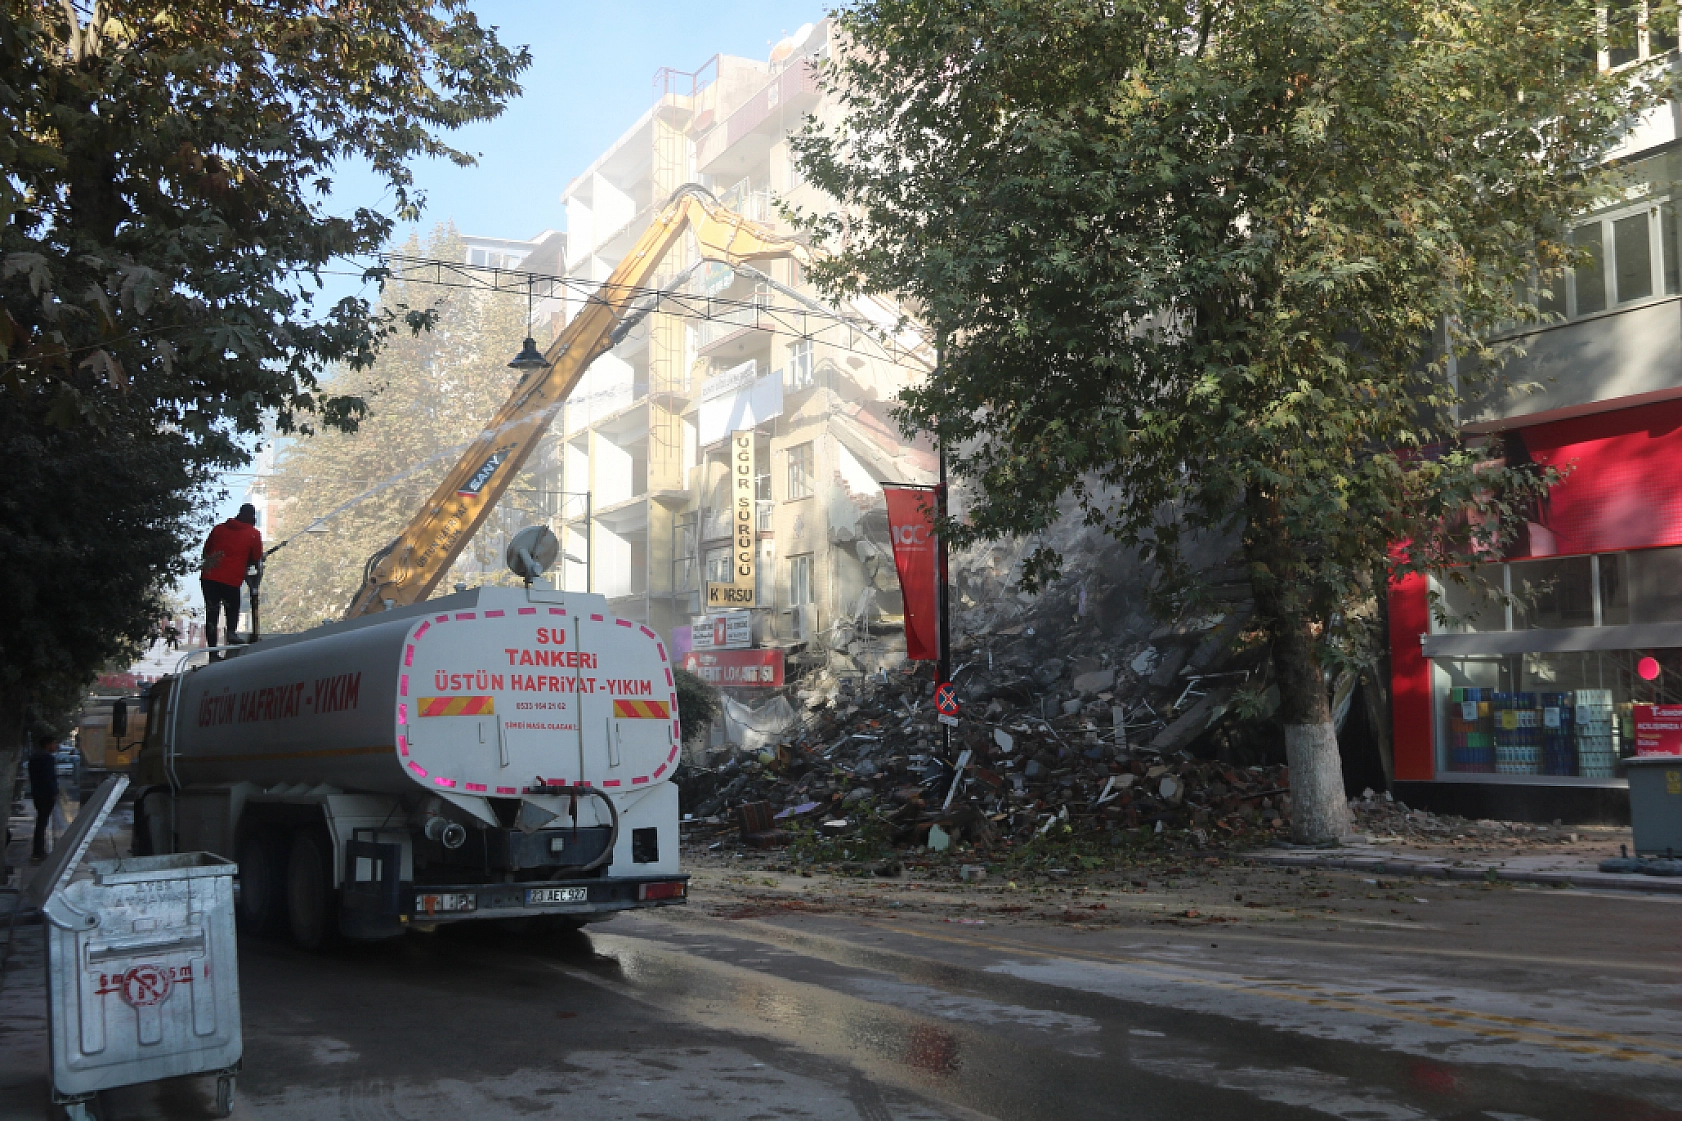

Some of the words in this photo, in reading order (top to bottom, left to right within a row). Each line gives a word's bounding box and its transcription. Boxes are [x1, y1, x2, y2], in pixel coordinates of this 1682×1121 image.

[468, 454, 499, 491] SANY
[738, 497, 751, 576] SÜRÜCÜ
[536, 627, 566, 645] SU
[434, 670, 504, 691] ÜSTÜN
